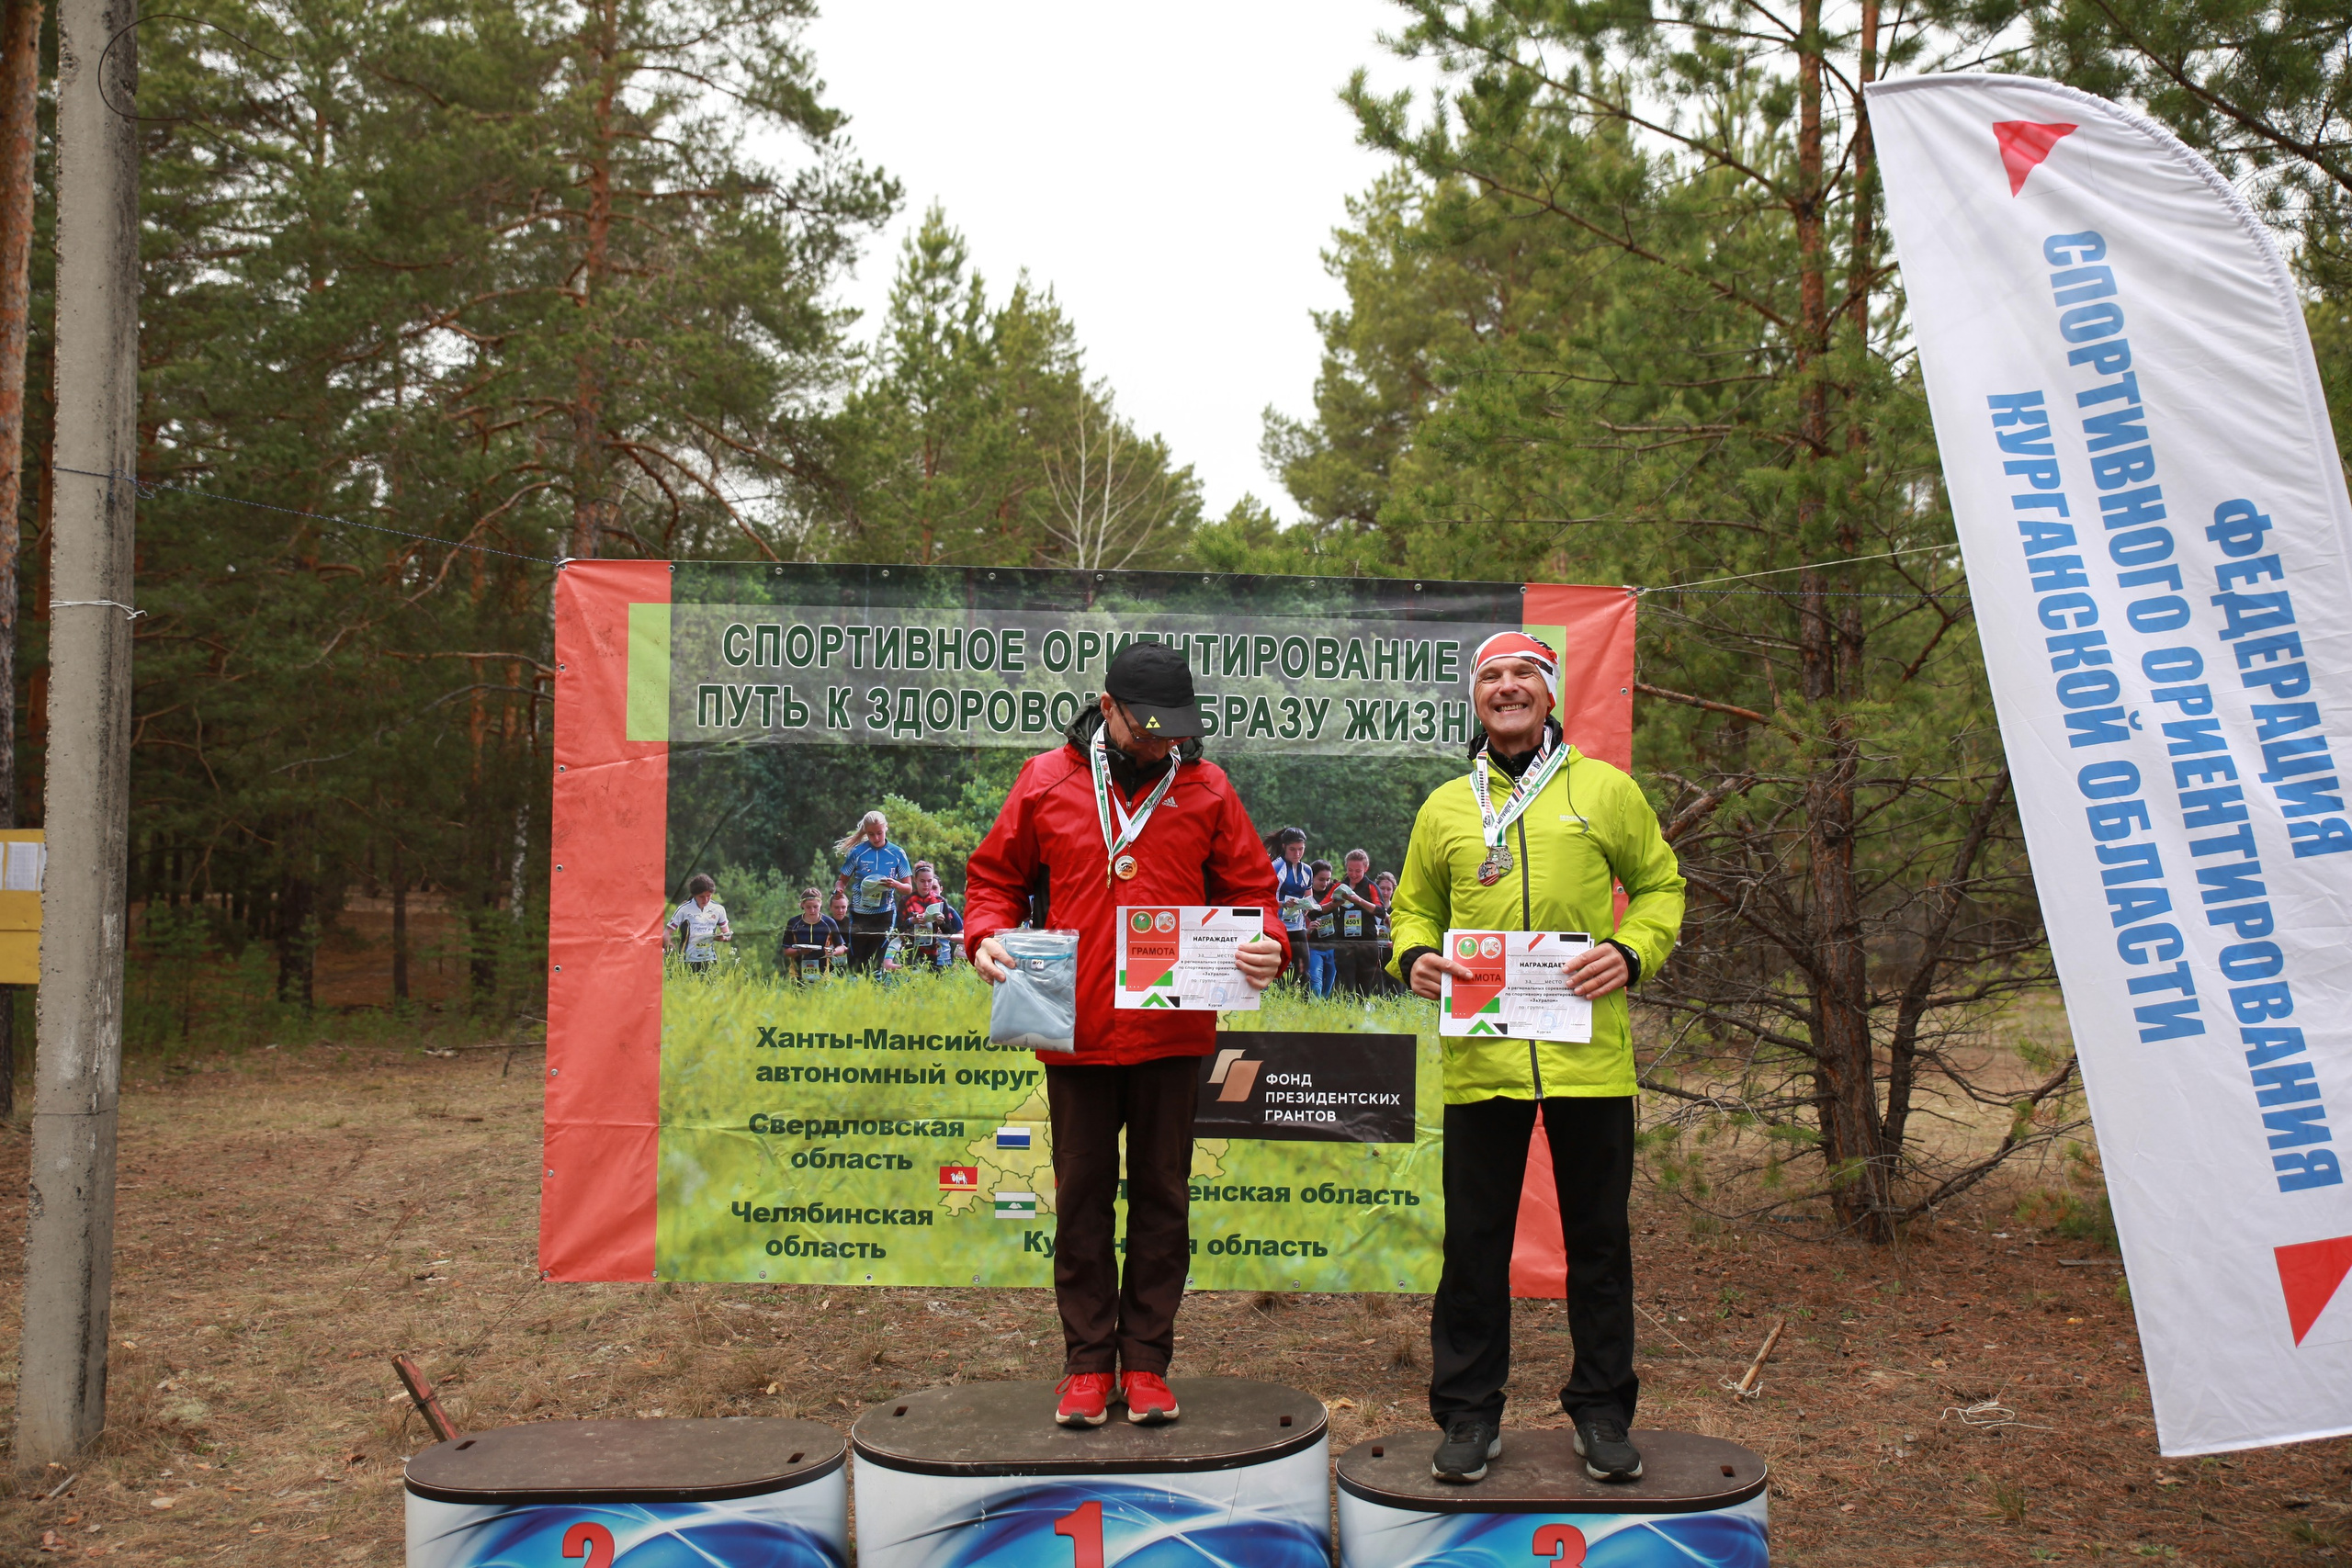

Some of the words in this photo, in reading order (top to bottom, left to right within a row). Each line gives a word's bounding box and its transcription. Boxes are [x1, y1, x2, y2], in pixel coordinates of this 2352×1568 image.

[722, 623, 1026, 672] СПОРТИВНОЕ
[1042, 629, 1460, 683] ОРИНТИРОВАНИЕ
[2205, 498, 2352, 859] ФЕДЕРАЦИЯ
[697, 683, 810, 728] ПУТЬ
[827, 686, 853, 730] К
[865, 686, 1097, 739] ЗДОРОВО
[1194, 694, 1330, 741] БРАЗУ
[1344, 699, 1482, 744] ЖИЗН
[1986, 389, 2143, 749] КУРГАНСКОЙ
[2077, 760, 2206, 1044] ОБЛАСТИ
[2043, 230, 2191, 634] СПОРТИВНОГО
[2141, 646, 2344, 1193] ОРИЕНТИРОВАНИЯ
[1131, 947, 1175, 955] ГРАМОТА
[755, 1063, 946, 1085] автономный
[955, 1069, 1039, 1091] округ
[1265, 1073, 1312, 1088] ФОНД
[1265, 1091, 1400, 1106] ПРЕЗИДЕНТСКИХ
[748, 1113, 965, 1140] Свердловская
[1265, 1110, 1336, 1122] ГРАНТОВ
[790, 1147, 913, 1170] область
[1300, 1181, 1420, 1206] область
[731, 1201, 933, 1225] Челябинская
[765, 1235, 887, 1259] область
[1207, 1233, 1328, 1258] область
[562, 1521, 615, 1568] 2
[1054, 1500, 1104, 1568] 1
